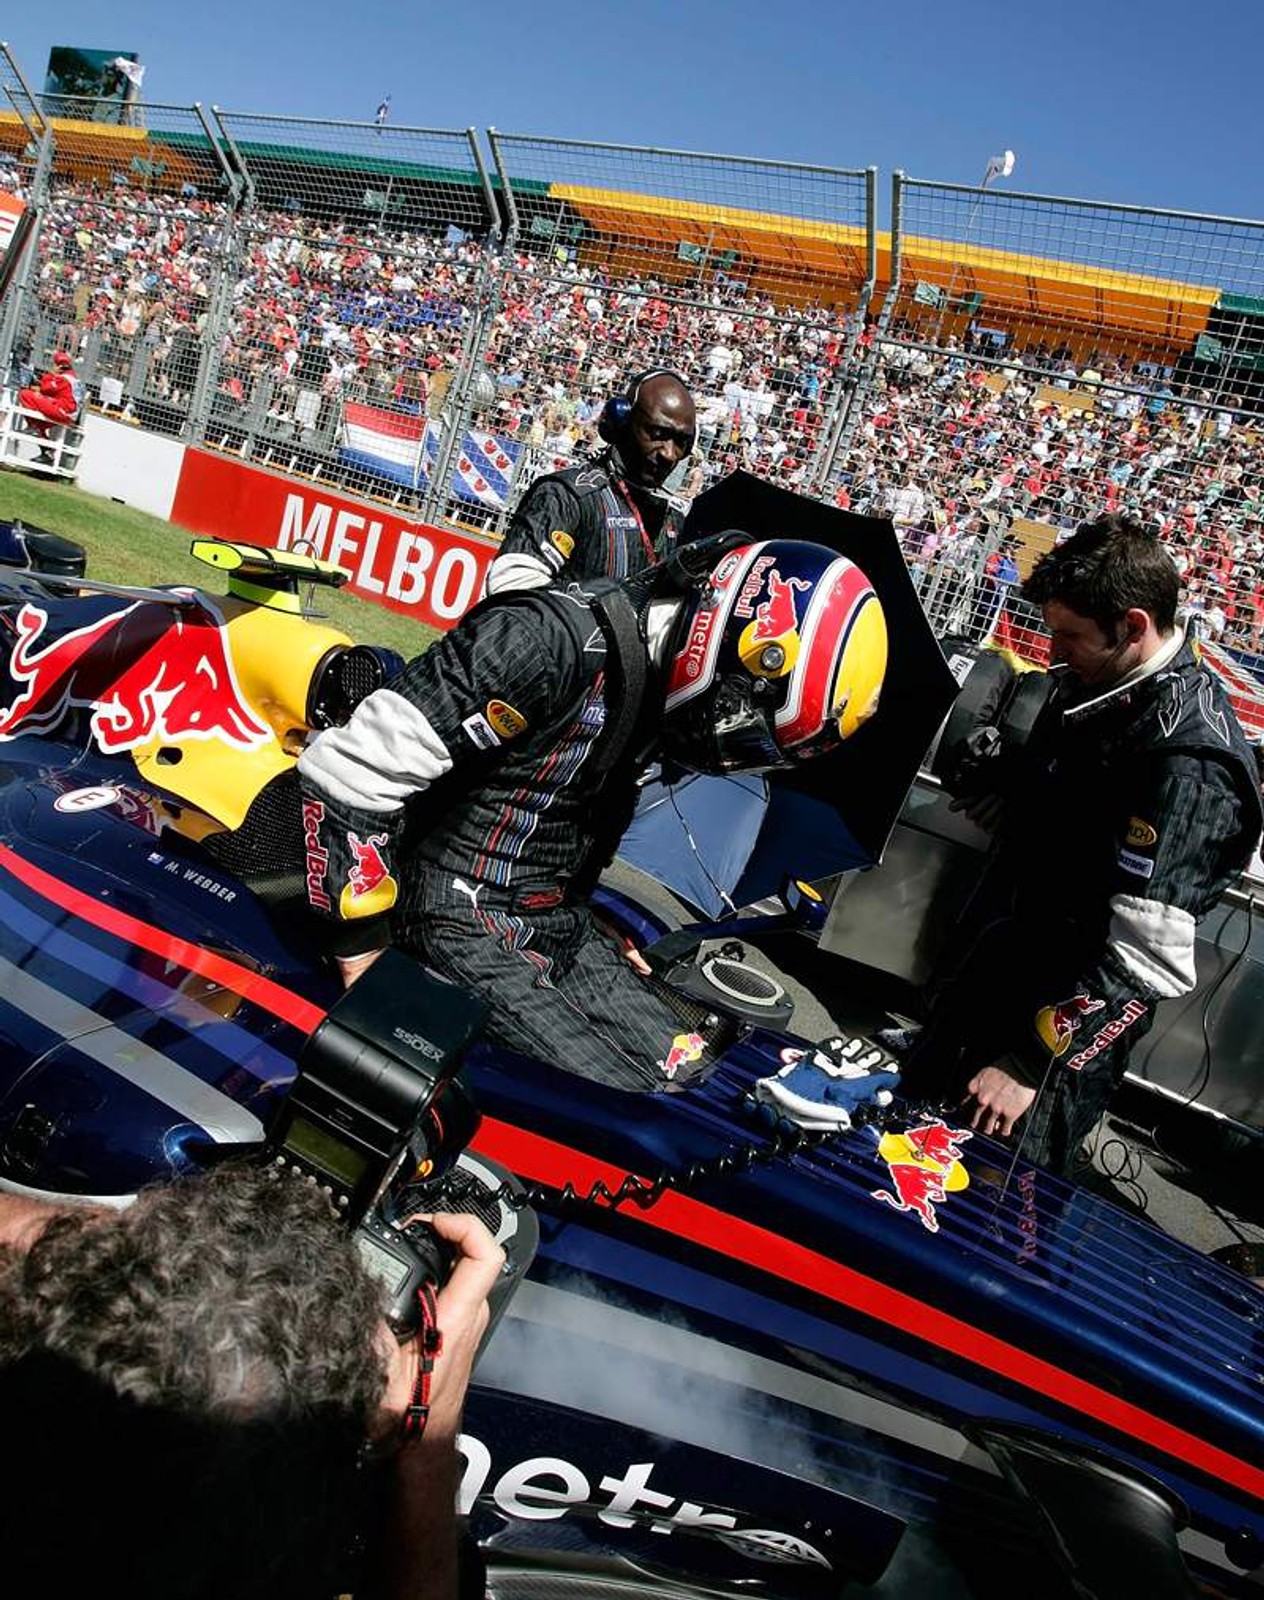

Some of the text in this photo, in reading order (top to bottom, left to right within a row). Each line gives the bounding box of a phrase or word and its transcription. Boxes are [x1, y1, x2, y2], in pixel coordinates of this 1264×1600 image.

[276, 493, 493, 620] MELBO
[164, 860, 237, 903] M. WEBBER
